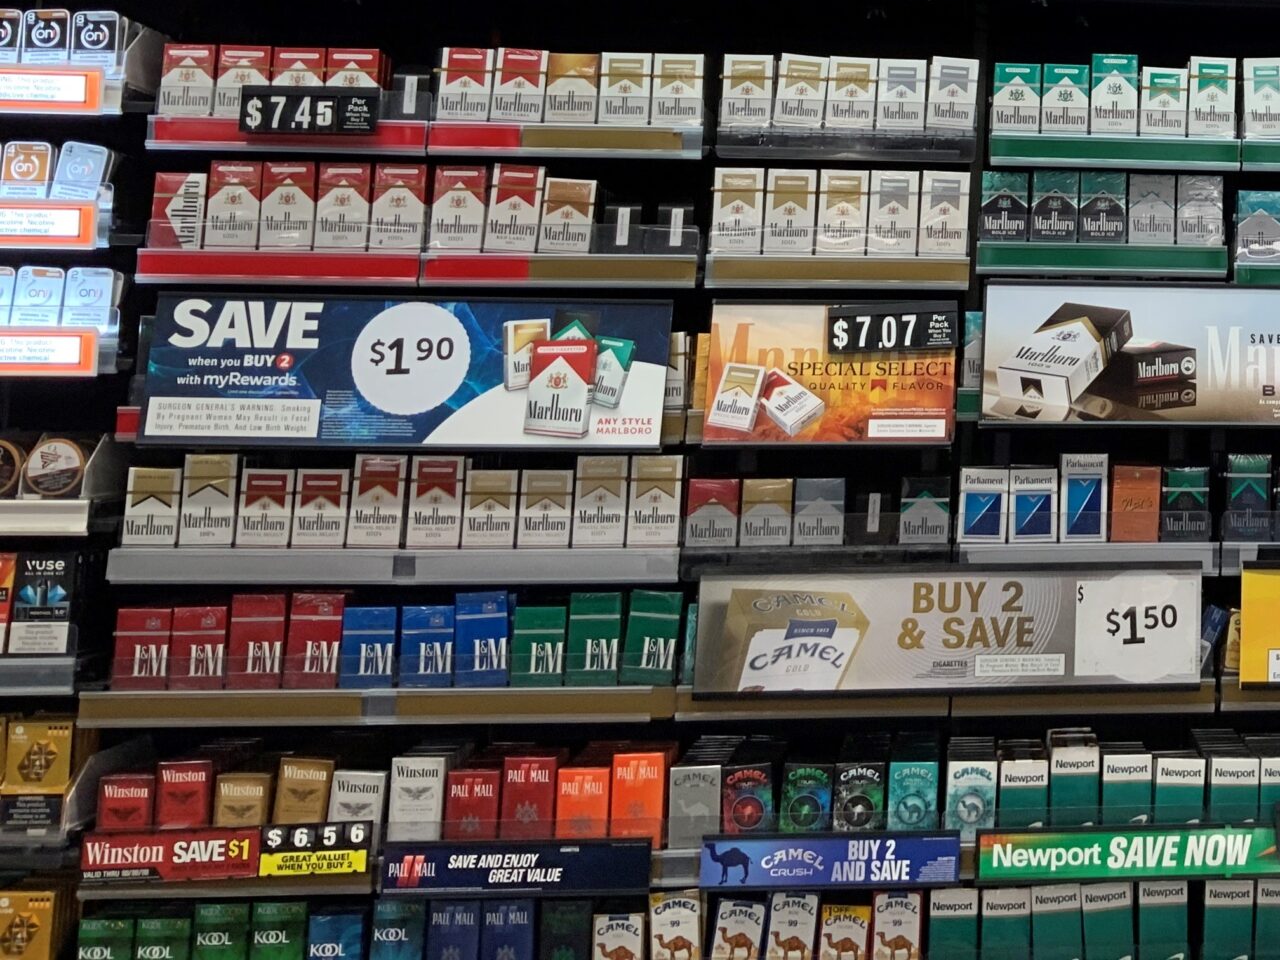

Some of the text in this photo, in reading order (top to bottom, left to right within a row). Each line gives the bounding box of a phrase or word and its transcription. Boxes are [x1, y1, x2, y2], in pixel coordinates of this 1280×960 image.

[168, 299, 324, 349] SAVE
[188, 355, 290, 368] when you BUY 2
[787, 361, 951, 376] SPECIAL SELECT
[177, 372, 297, 388] with myRewards
[912, 581, 1023, 614] BUY 2
[897, 616, 1034, 650] & SAVE
[133, 642, 168, 678] L&M
[86, 840, 249, 865] Winston SAVE $1
[448, 853, 538, 869] SAVE AND ENJOY
[761, 839, 896, 870] CAMEL BUY 2
[992, 843, 1101, 870] Newport
[1107, 835, 1179, 868] SAVE
[1184, 834, 1251, 866] NOW
[389, 861, 435, 878] PALL MALL
[489, 868, 562, 883] GREAT VALUE
[770, 868, 813, 877] CRUSH
[831, 861, 866, 882] AND
[870, 860, 910, 880] SAVE
